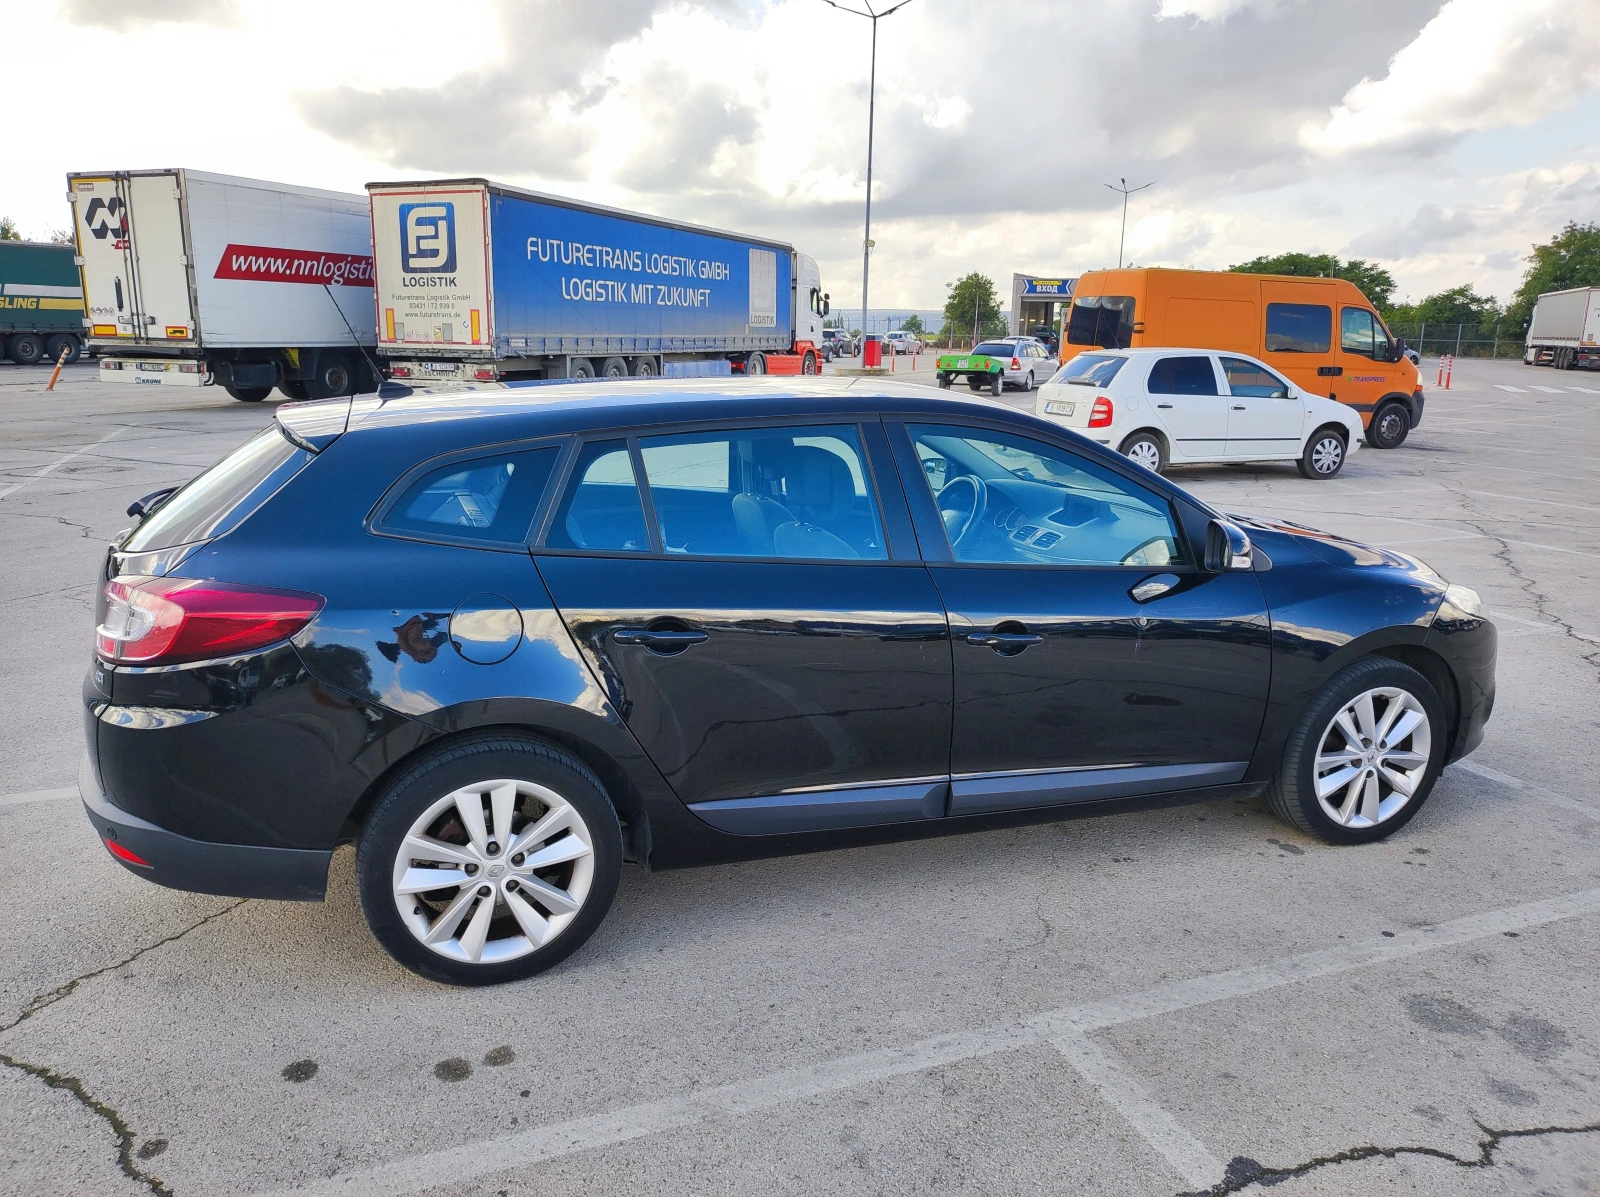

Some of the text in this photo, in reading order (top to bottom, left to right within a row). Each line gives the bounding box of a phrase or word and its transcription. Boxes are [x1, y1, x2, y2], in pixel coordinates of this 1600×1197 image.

[527, 237, 730, 281] FUTURETRANS LOGISTIK GMBH
[402, 276, 457, 287] LOGISTIK
[562, 276, 711, 308] LOGISTIK MIT ZUKUNFT
[1036, 285, 1058, 293] ВХОД
[391, 293, 425, 301] Futuretrans
[426, 293, 450, 303] Logistik
[750, 315, 775, 325] LOGISTIK
[427, 370, 459, 378] SCHMITZ
